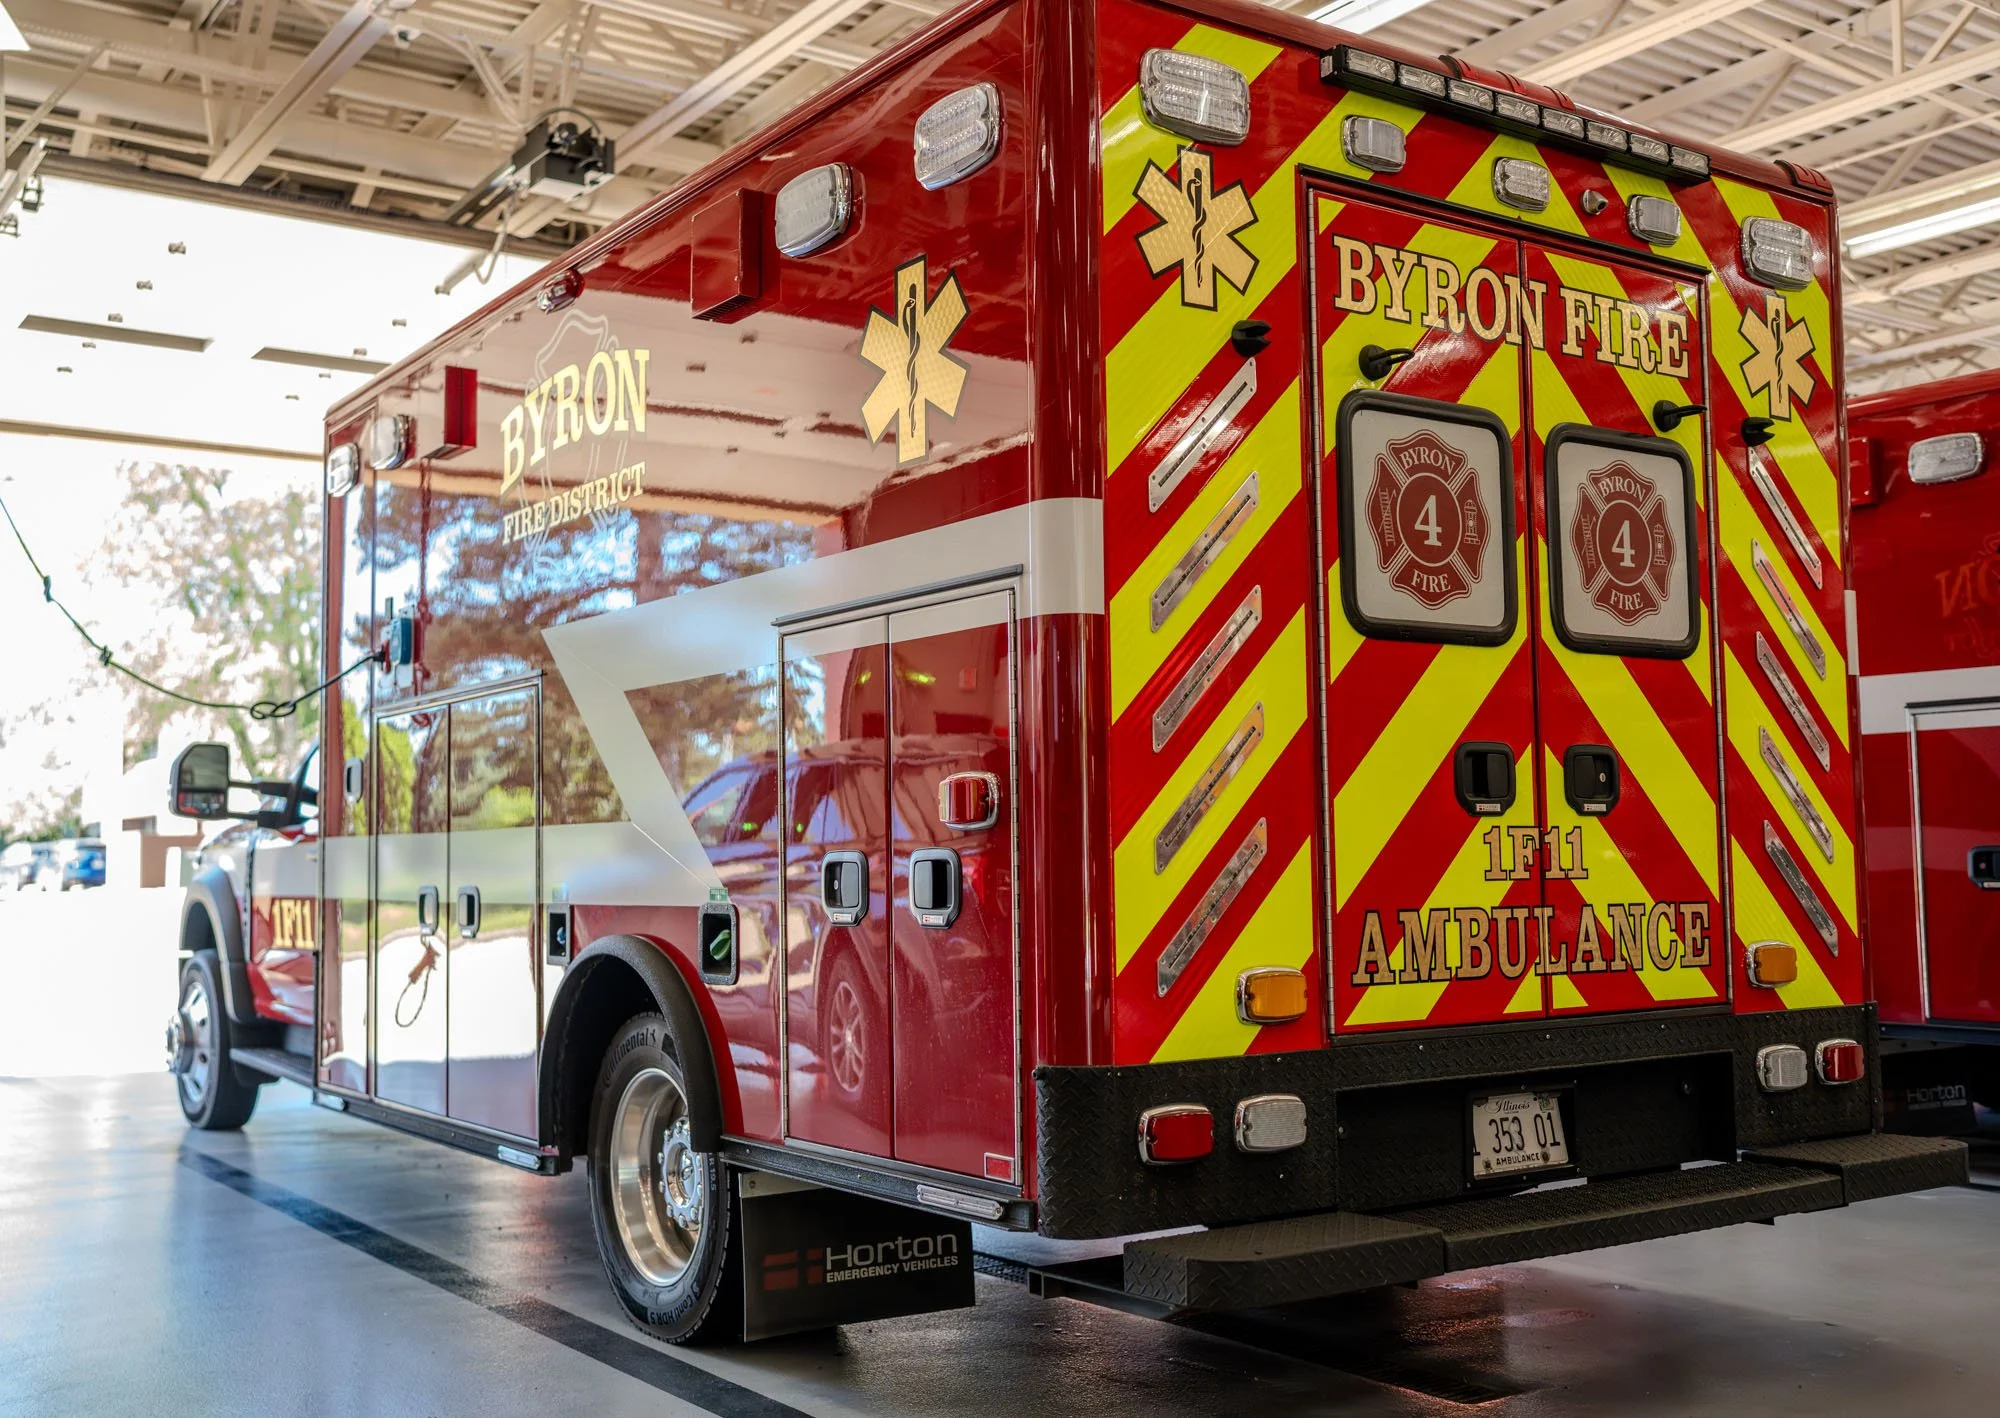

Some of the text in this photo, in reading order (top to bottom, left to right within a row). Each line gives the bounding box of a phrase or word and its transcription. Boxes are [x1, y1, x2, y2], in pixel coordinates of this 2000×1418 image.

[1333, 234, 1690, 379] BYRON FIRE
[501, 348, 650, 496] BYRON
[1399, 446, 1456, 477] BYRON
[502, 461, 646, 546] FIRE DISTRICT
[1598, 475, 1645, 502] BYRON
[1414, 494, 1442, 546] 4
[1612, 519, 1635, 568] 4
[1411, 568, 1451, 593] FIRE
[1610, 589, 1643, 610] FIRE
[1483, 825, 1588, 881] 1F11
[271, 898, 315, 950] 1F11
[1351, 901, 1711, 987] AMBULANCE
[1484, 1100, 1530, 1114] Illinois
[1906, 1085, 1966, 1103] Horton
[1488, 1112, 1560, 1153] 353 01
[1496, 1152, 1541, 1166] AMBULANCE
[826, 1234, 958, 1270] Horton
[826, 1255, 959, 1283] EMERGENCY VEHICLES
